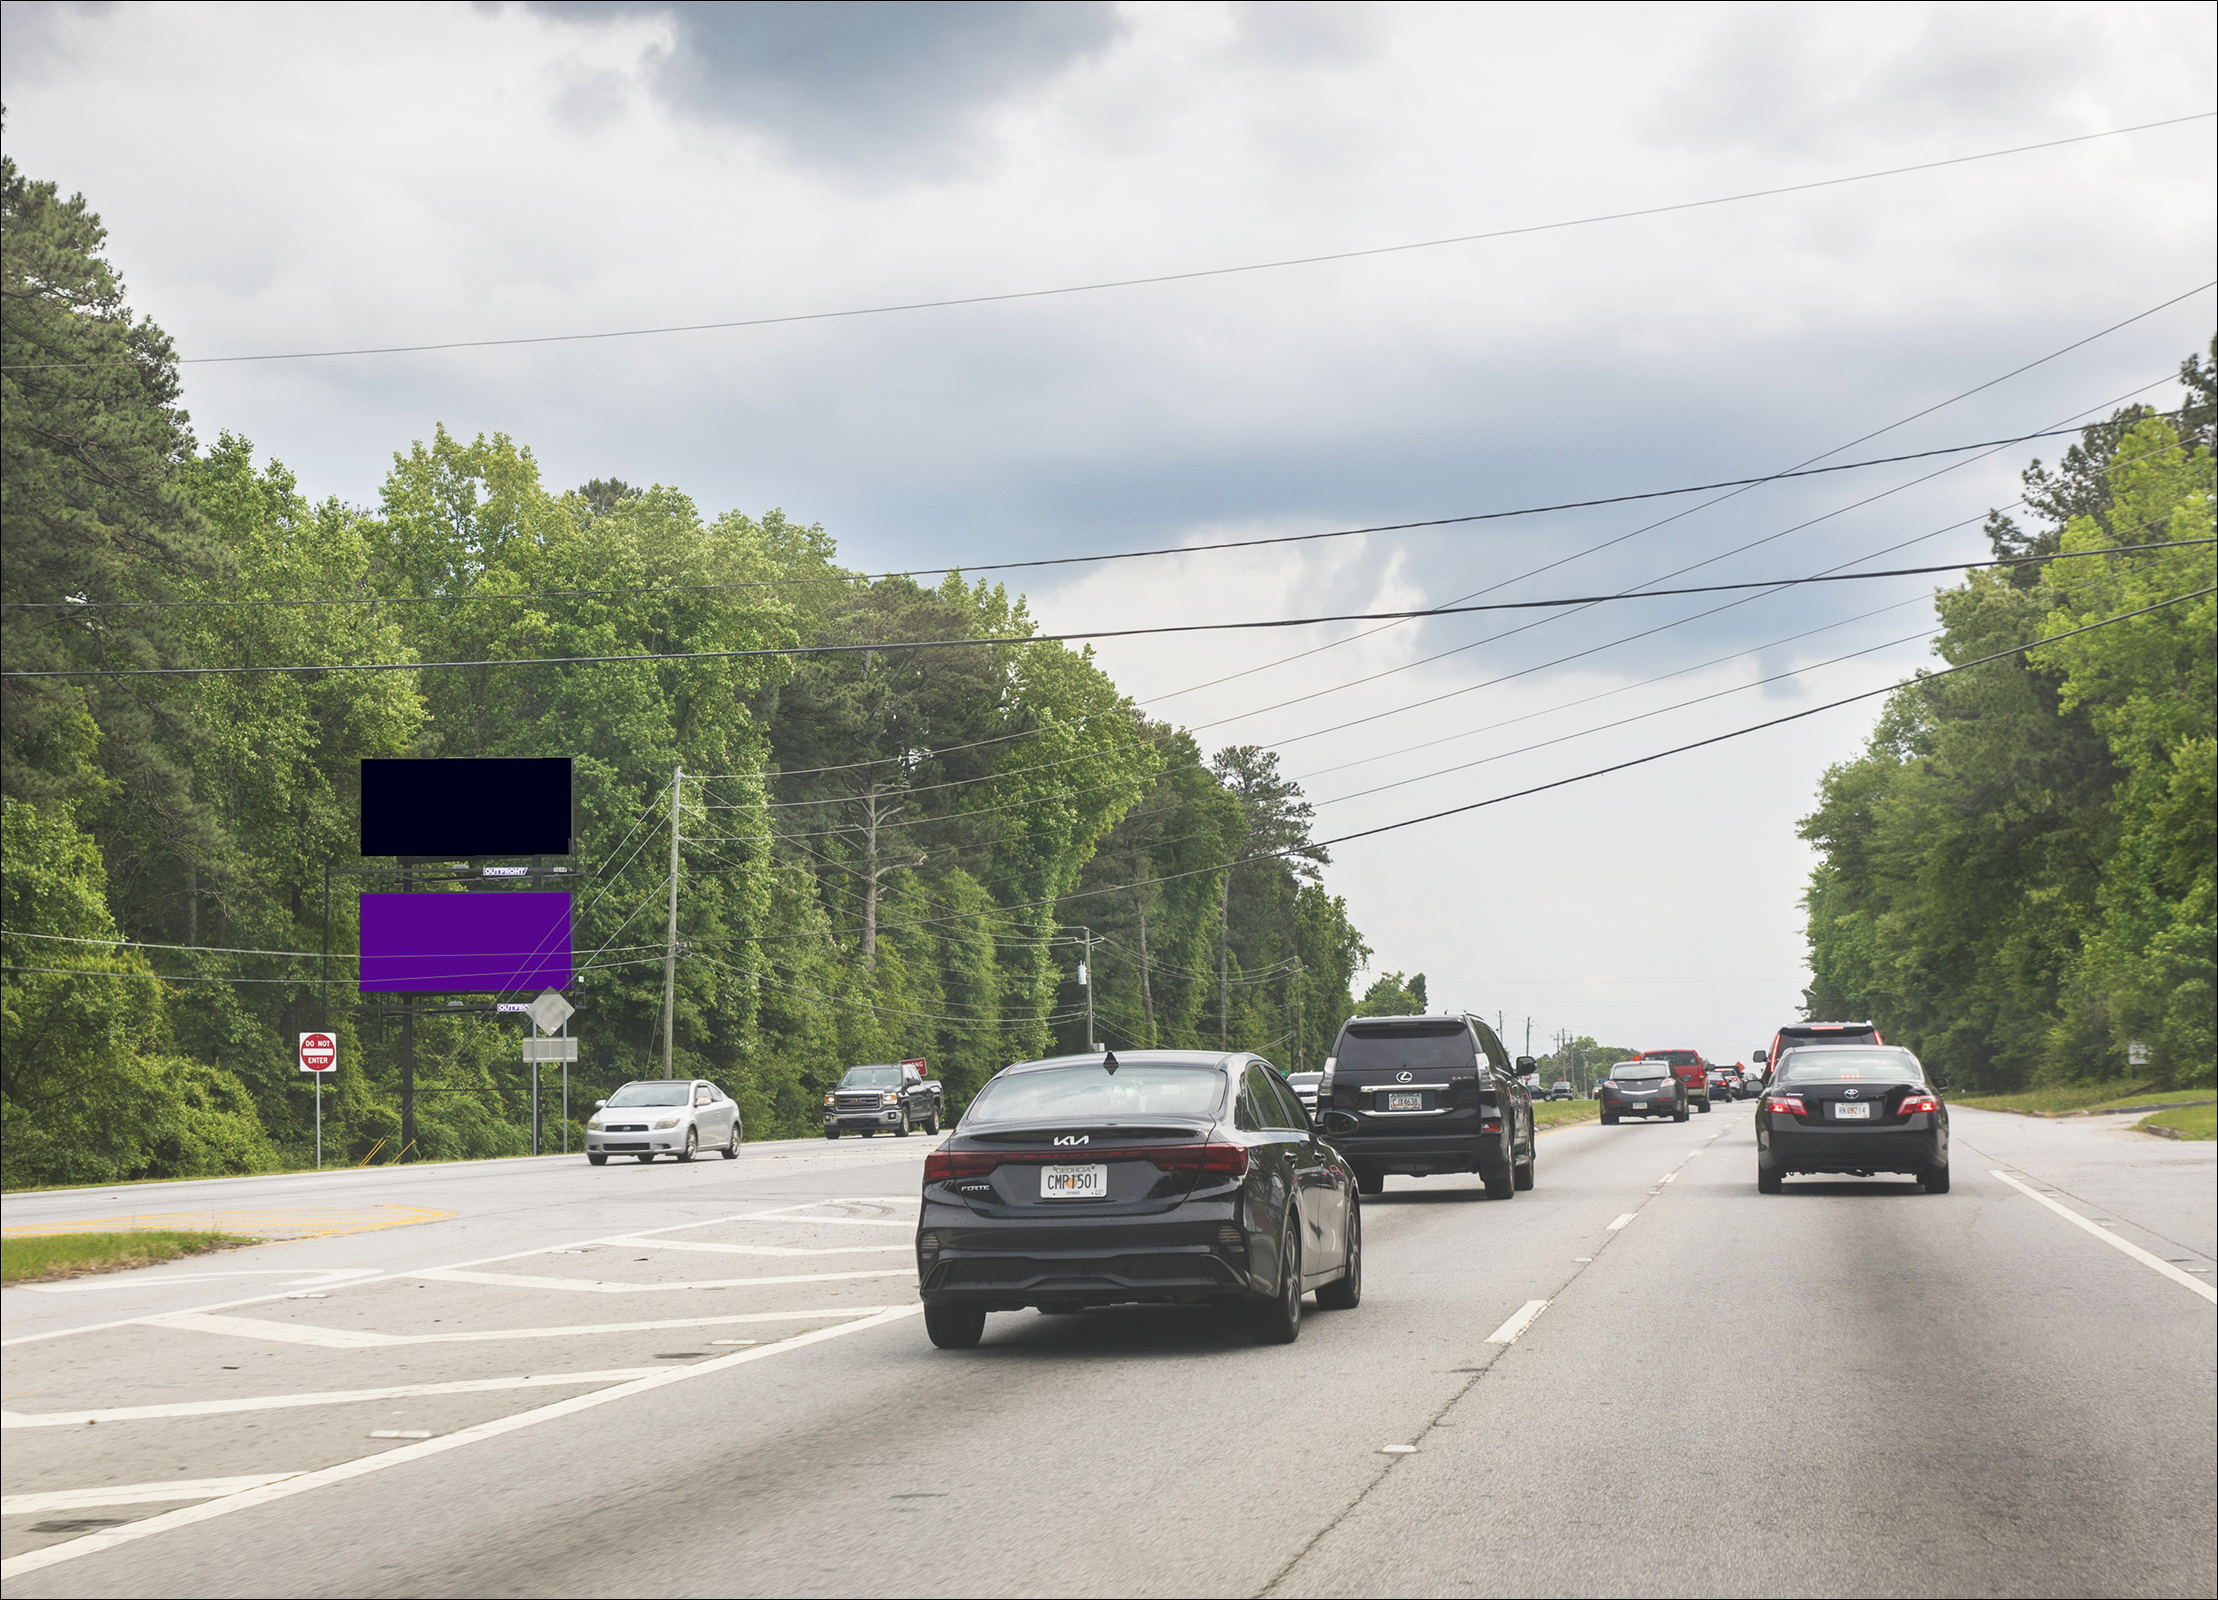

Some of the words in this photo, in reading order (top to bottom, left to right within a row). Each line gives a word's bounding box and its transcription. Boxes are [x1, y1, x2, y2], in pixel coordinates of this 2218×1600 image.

[484, 867, 525, 875] OUTFRONT
[498, 1004, 530, 1012] OUTFRO
[1053, 1135, 1089, 1146] KIA
[1055, 1166, 1091, 1174] GEORGIA
[1047, 1173, 1097, 1190] CMP1501
